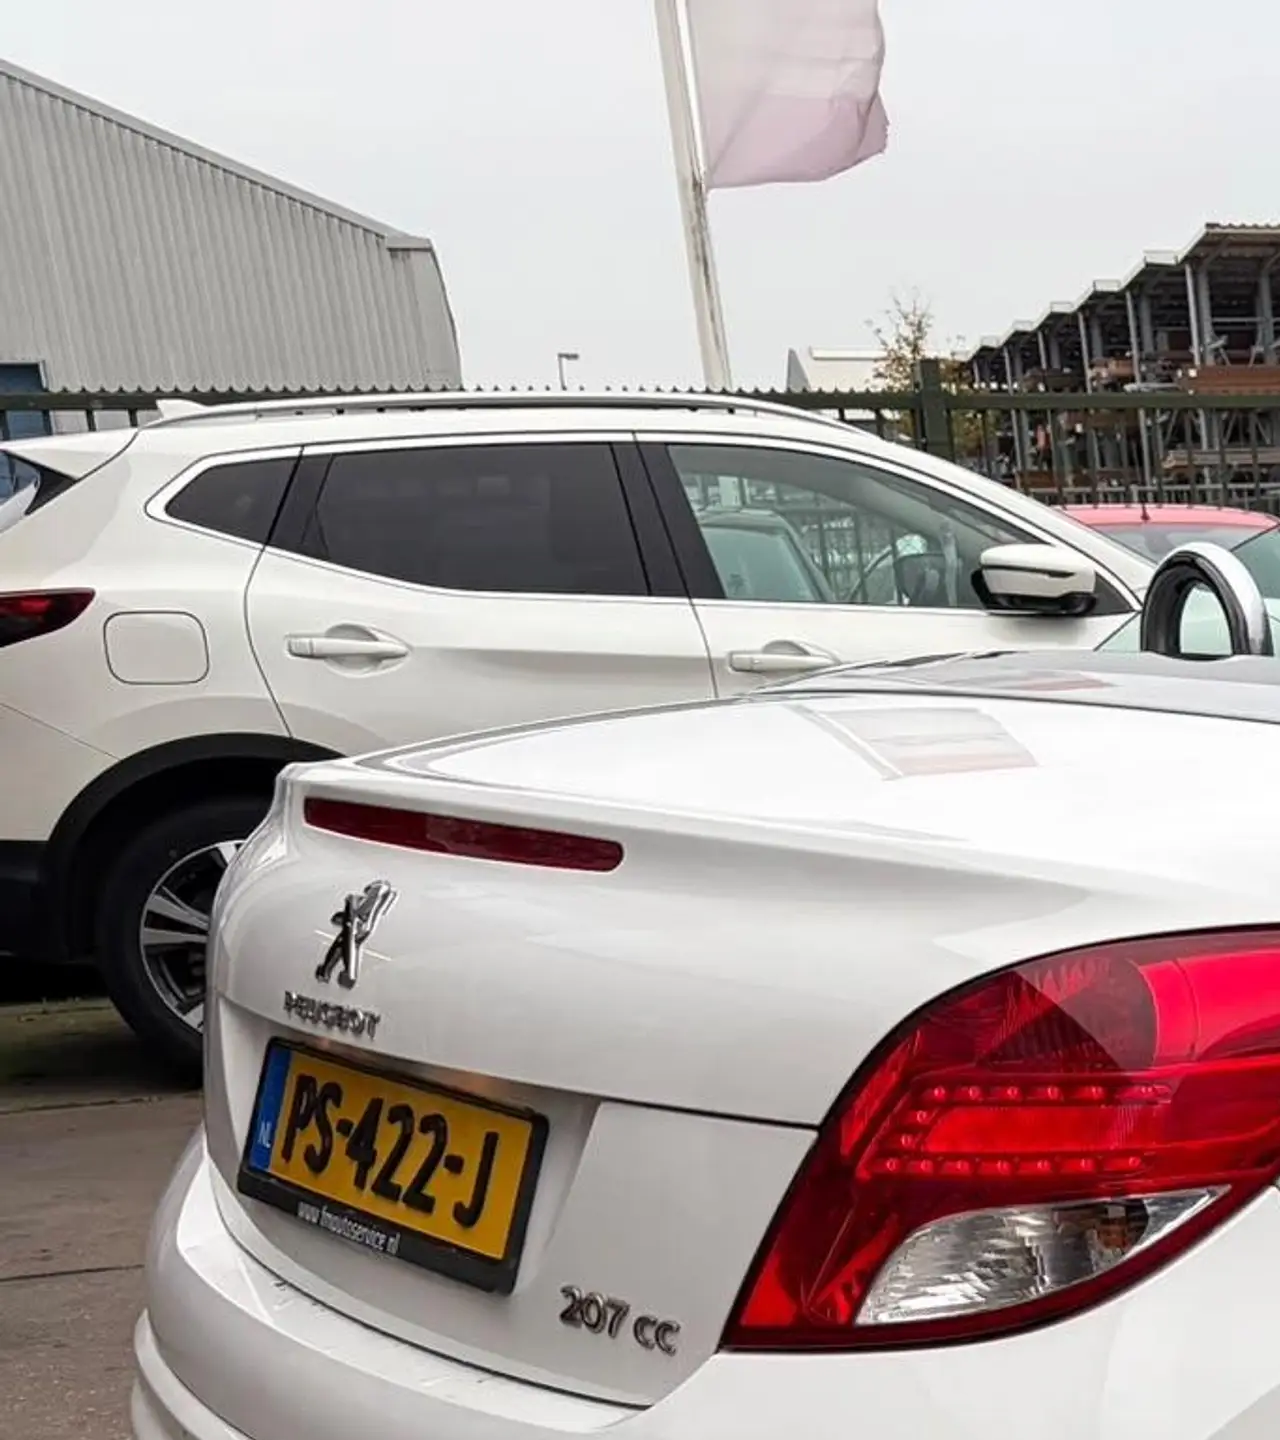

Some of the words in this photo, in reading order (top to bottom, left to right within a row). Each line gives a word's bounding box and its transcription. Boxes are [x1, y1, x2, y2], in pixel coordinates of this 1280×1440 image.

[284, 990, 381, 1040] PEUGEOT
[281, 1074, 500, 1228] PS-422-J
[559, 1284, 631, 1340] 207
[633, 1315, 681, 1357] CC
